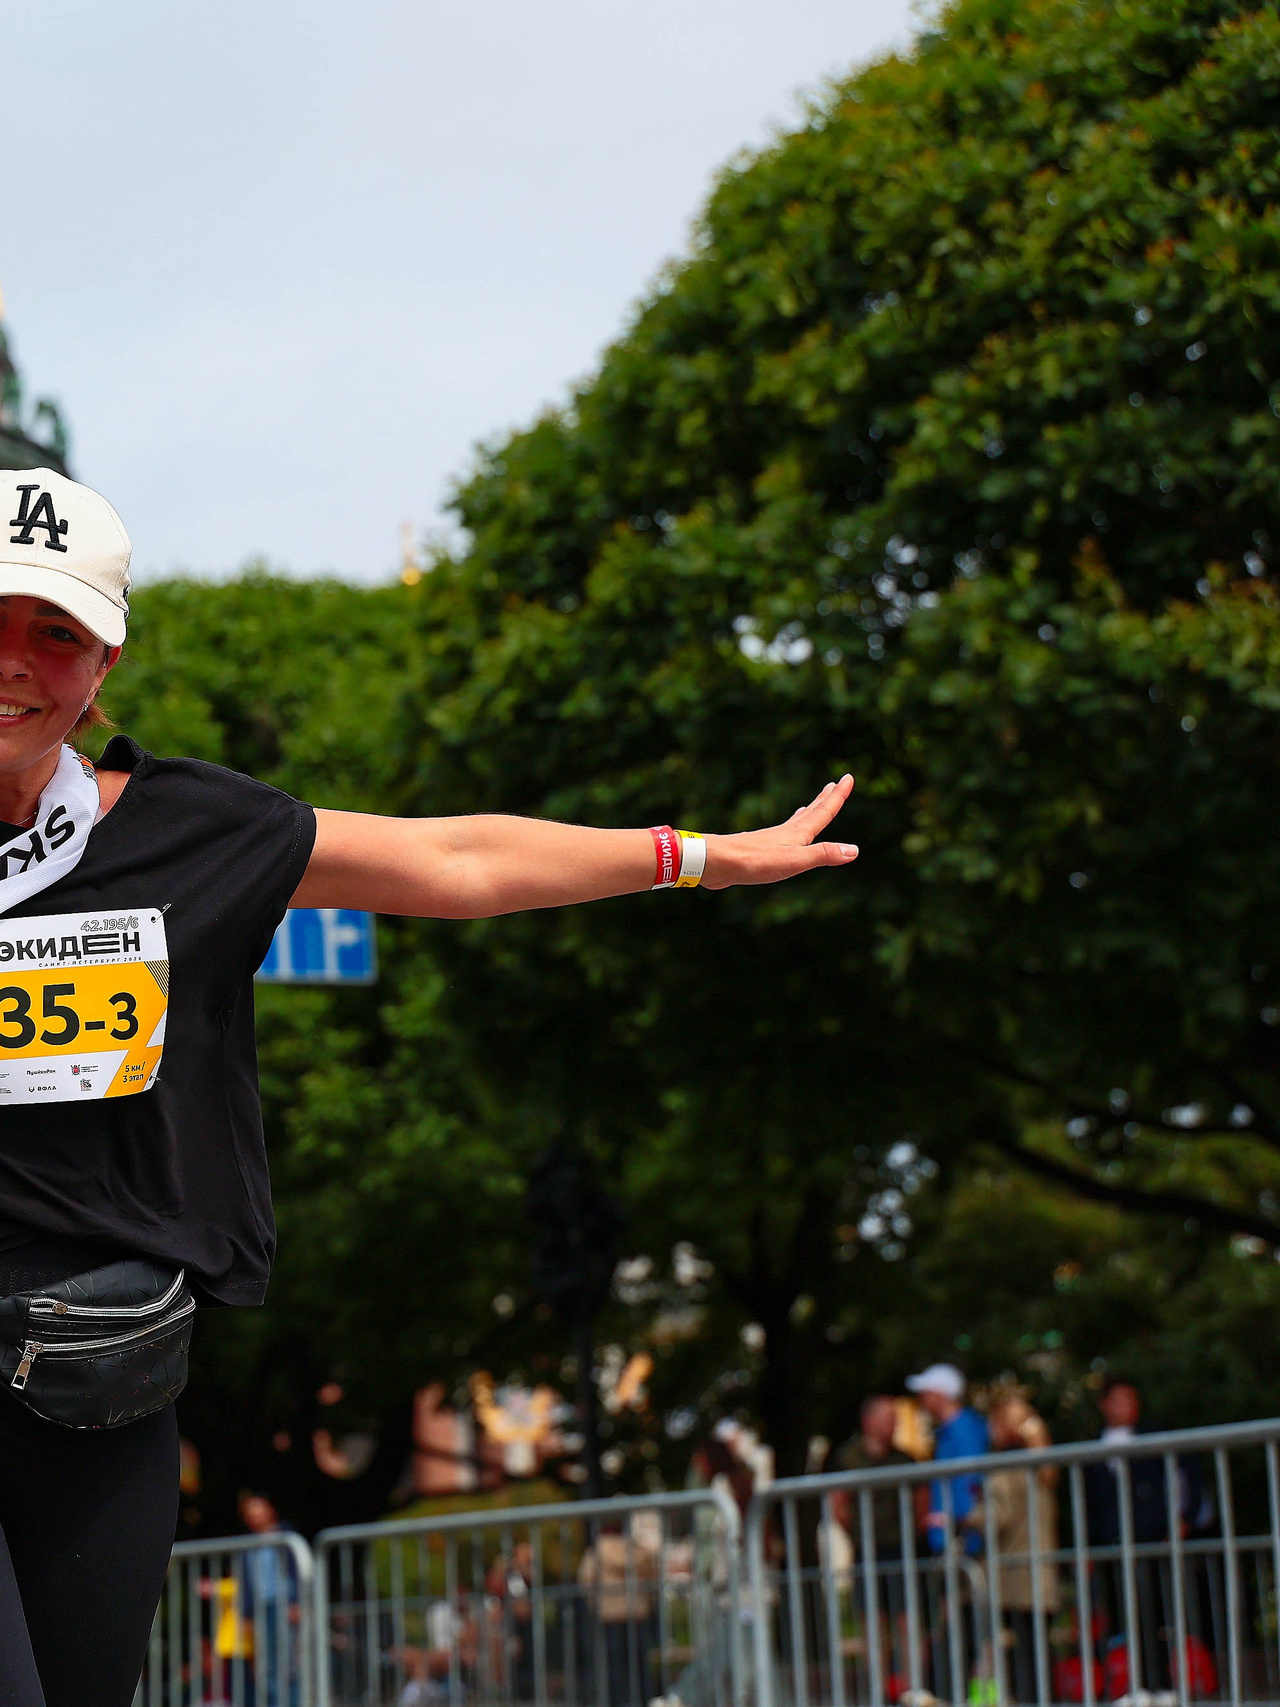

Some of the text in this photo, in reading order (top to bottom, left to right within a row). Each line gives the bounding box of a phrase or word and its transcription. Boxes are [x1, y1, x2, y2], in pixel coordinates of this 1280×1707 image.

[10, 485, 68, 553] LA
[80, 915, 139, 932] 42.195/6
[125, 1064, 130, 1072] 5
[122, 1075, 128, 1083] 3
